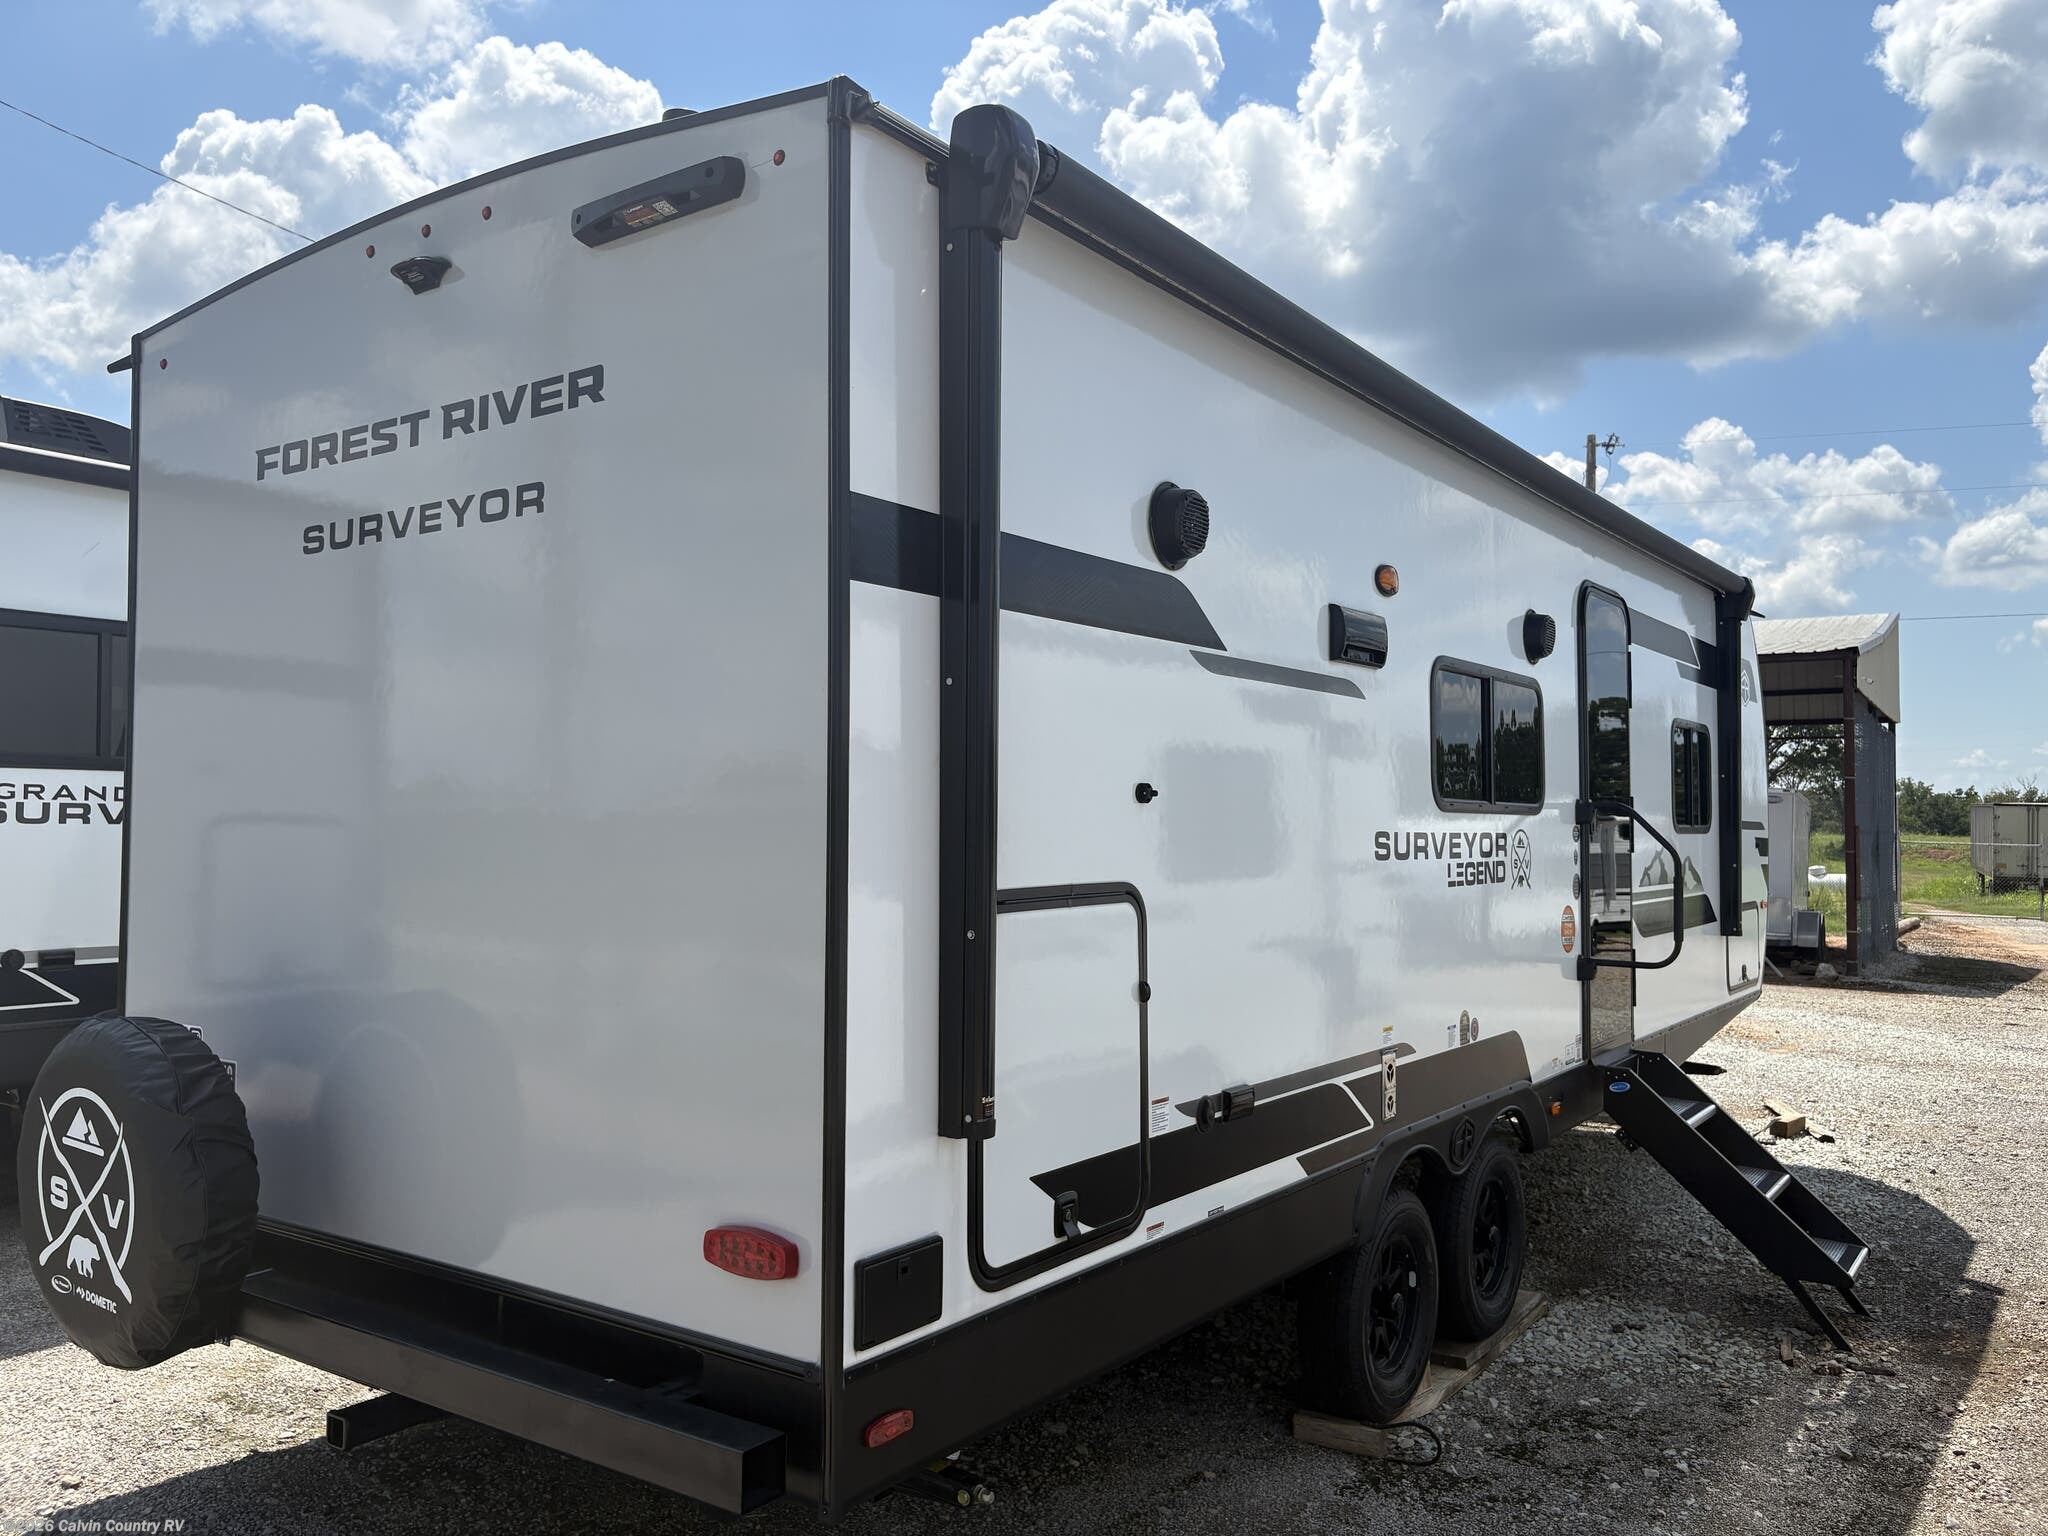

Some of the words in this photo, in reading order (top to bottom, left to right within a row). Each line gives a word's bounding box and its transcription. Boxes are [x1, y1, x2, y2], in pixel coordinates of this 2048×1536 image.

[255, 409, 431, 482] FOREST
[440, 364, 606, 441] RIVER
[302, 481, 546, 556] SURVEYOR
[0, 801, 124, 825] URV
[1374, 830, 1508, 861] SURVEYOR
[1447, 860, 1506, 888] LEGEND
[50, 1175, 68, 1210] S
[102, 1192, 125, 1230] V
[85, 1289, 117, 1314] DOMETIC
